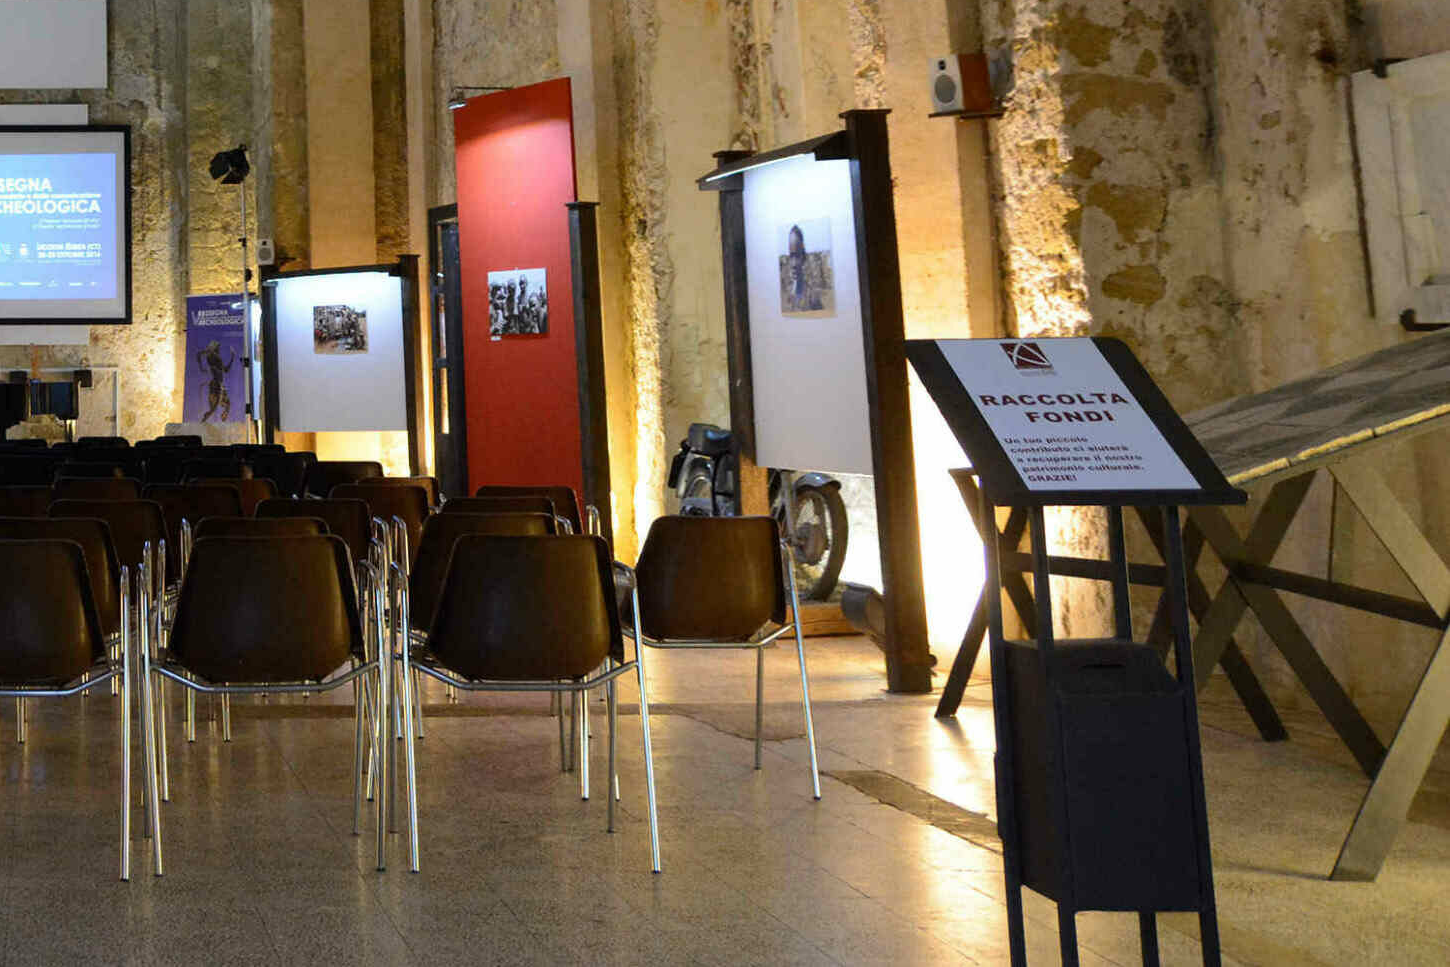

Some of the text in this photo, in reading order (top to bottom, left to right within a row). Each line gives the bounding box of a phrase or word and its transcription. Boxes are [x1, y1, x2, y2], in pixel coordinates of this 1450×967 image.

[978, 393, 1130, 406] RACCOLTA
[1024, 410, 1115, 424] FONDI
[1045, 436, 1090, 444] piccolo
[1010, 445, 1071, 453] contributo
[1022, 464, 1085, 472] patrimonio
[1027, 474, 1078, 482] GRAZIE!
